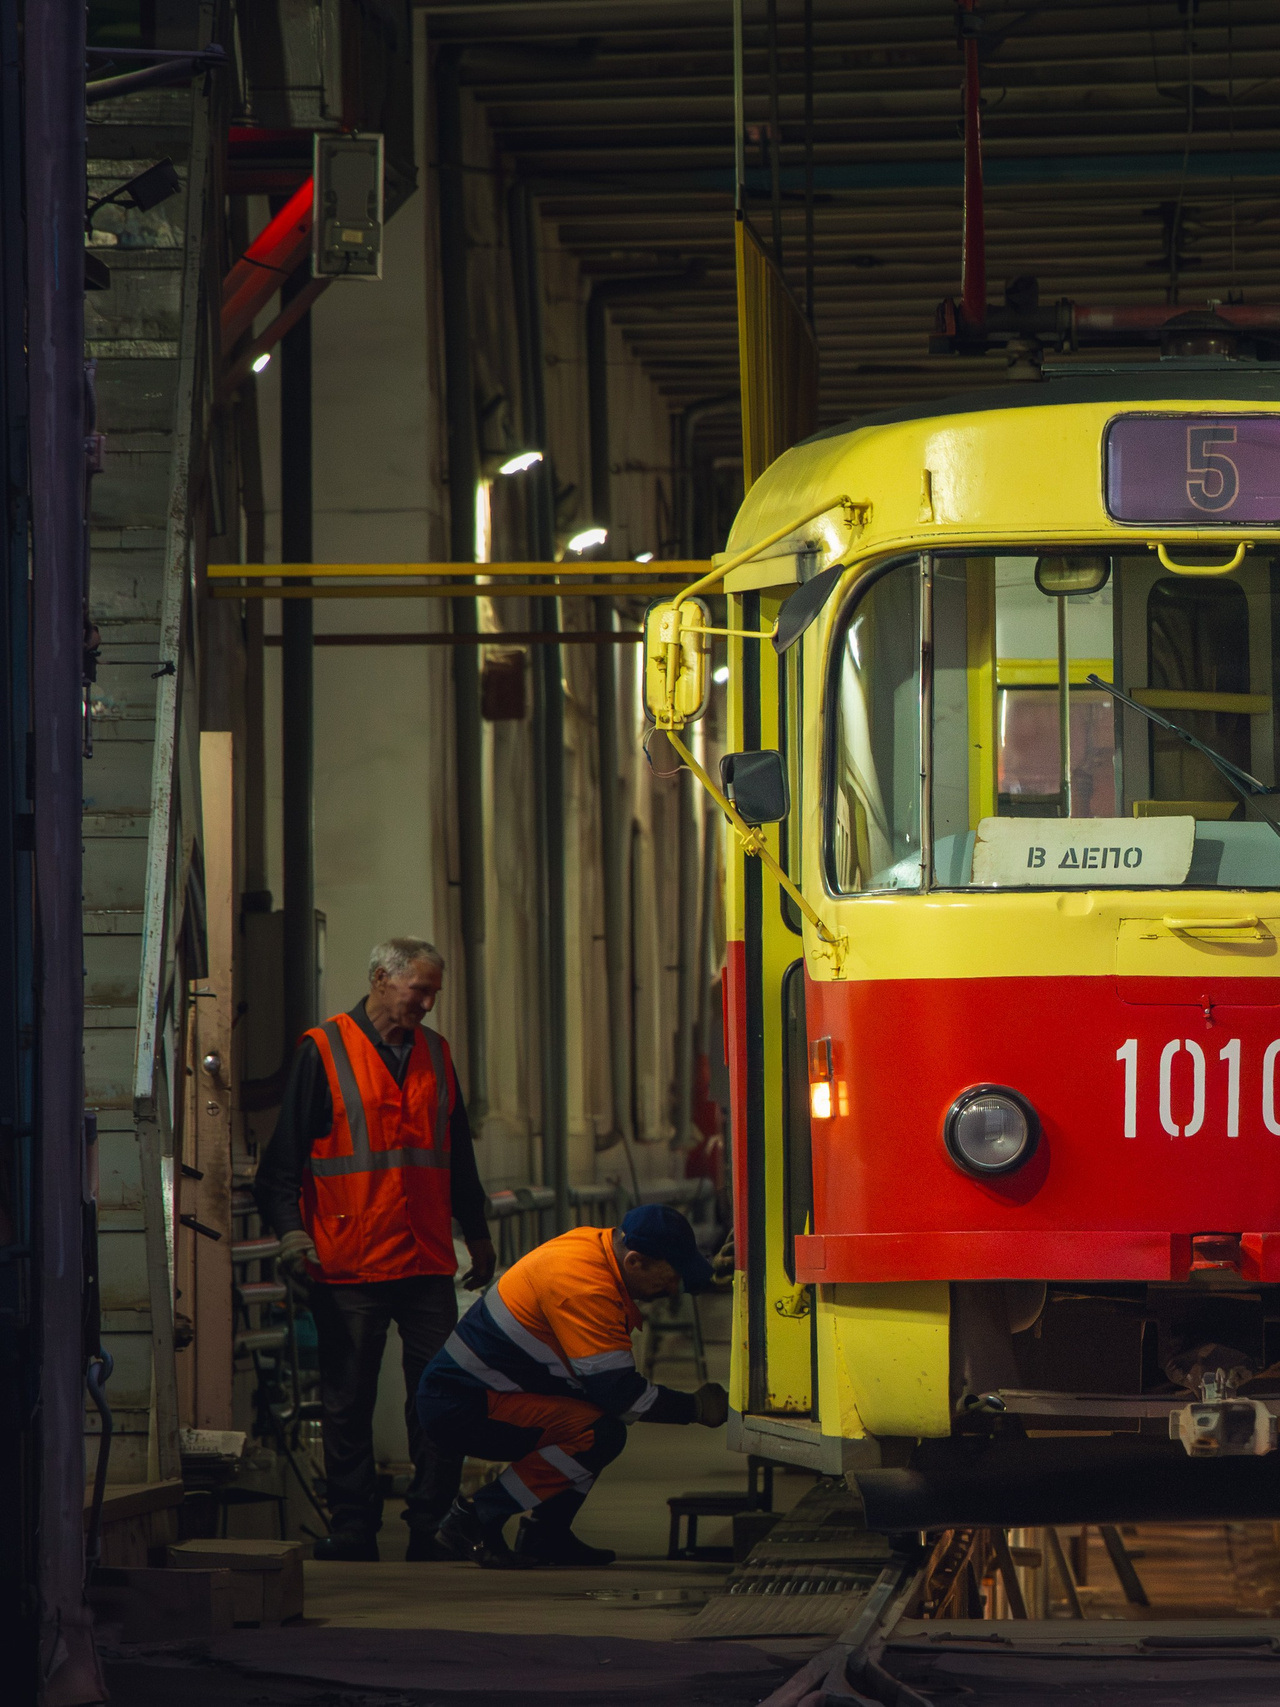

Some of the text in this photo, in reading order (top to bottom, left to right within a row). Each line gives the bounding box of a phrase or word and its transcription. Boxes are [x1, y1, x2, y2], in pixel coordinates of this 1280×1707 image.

[1186, 425, 1239, 512] 5
[1027, 847, 1142, 868] В ДЕПО
